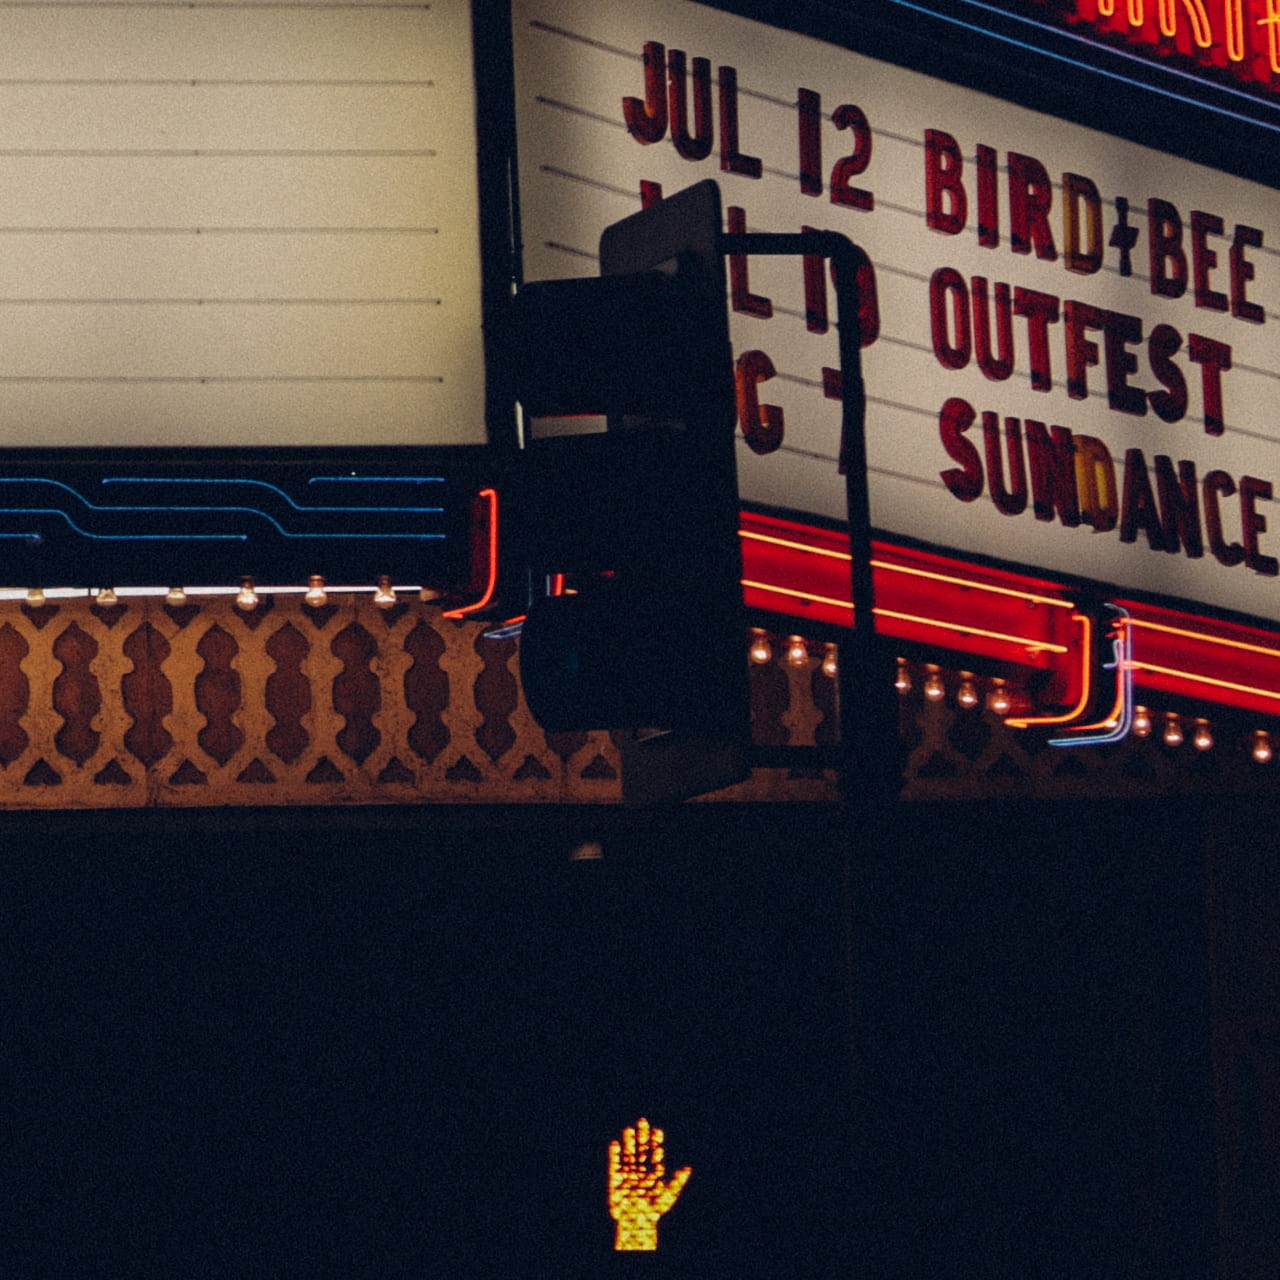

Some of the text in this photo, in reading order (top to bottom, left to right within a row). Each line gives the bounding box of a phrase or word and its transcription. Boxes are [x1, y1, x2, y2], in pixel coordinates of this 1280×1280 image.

[621, 40, 763, 180] JUL
[797, 86, 875, 213] 12
[929, 265, 1233, 437] OUTFEST
[939, 396, 1280, 577] SUNDANCE
